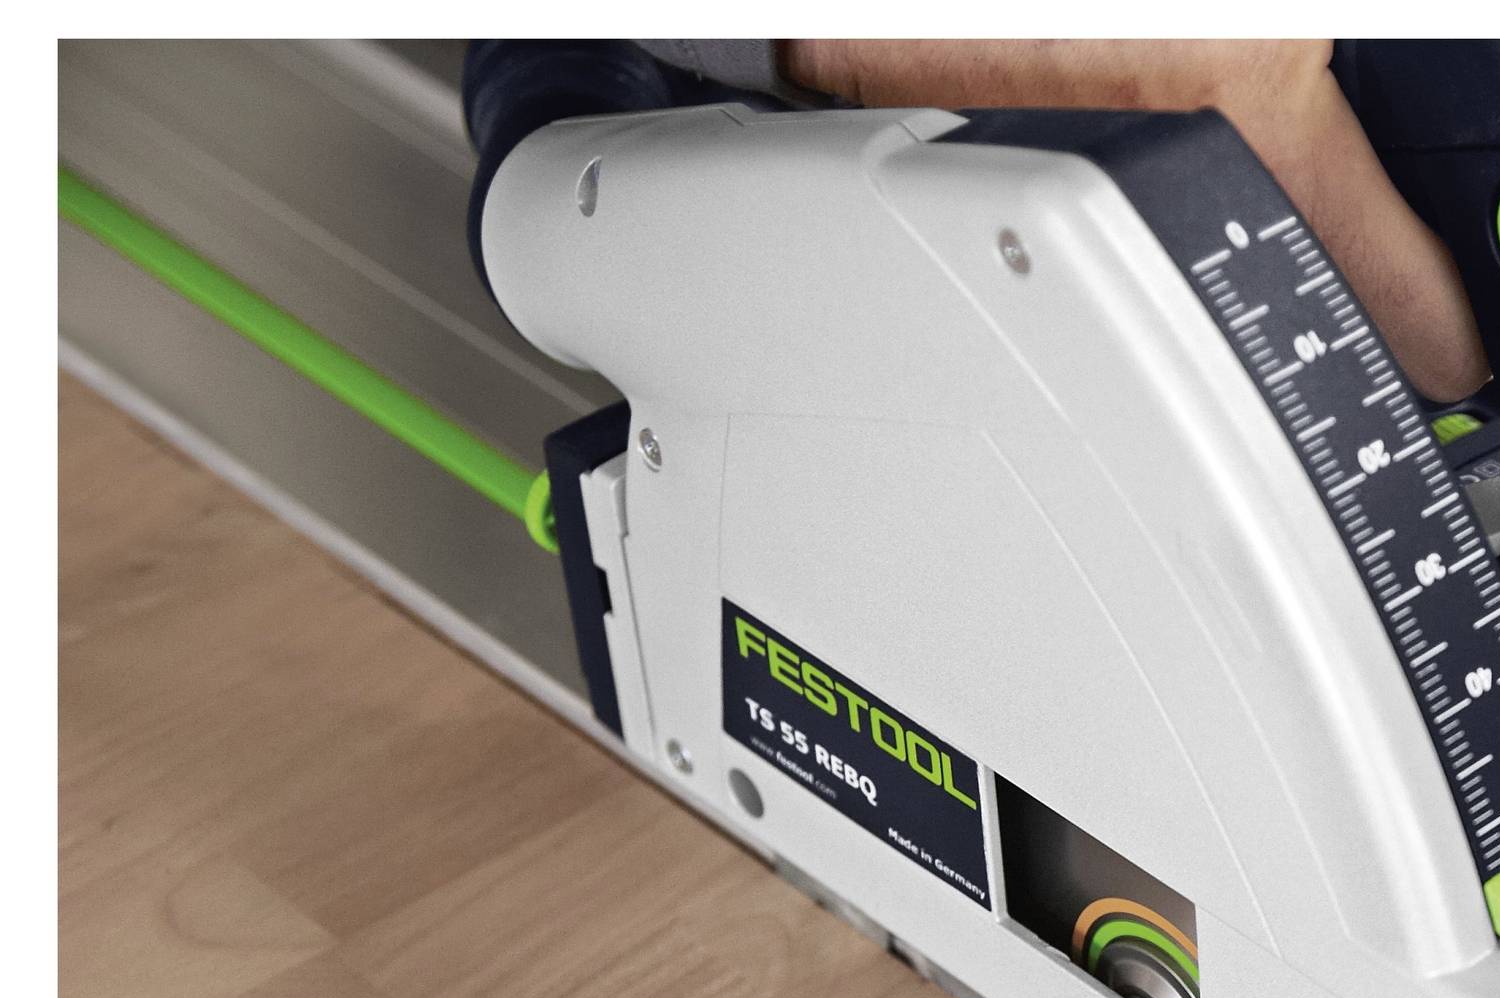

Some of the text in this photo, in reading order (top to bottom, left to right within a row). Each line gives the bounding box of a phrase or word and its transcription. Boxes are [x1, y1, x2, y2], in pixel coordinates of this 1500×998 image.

[1225, 220, 1250, 249] 0
[1293, 330, 1327, 363] 10
[1357, 439, 1391, 474] 20
[1414, 552, 1446, 587] 30
[1464, 667, 1492, 698] 40
[735, 616, 977, 810] FESTOOL
[745, 697, 878, 807] TS 55 REBQ
[888, 827, 986, 900] Made in Germany
